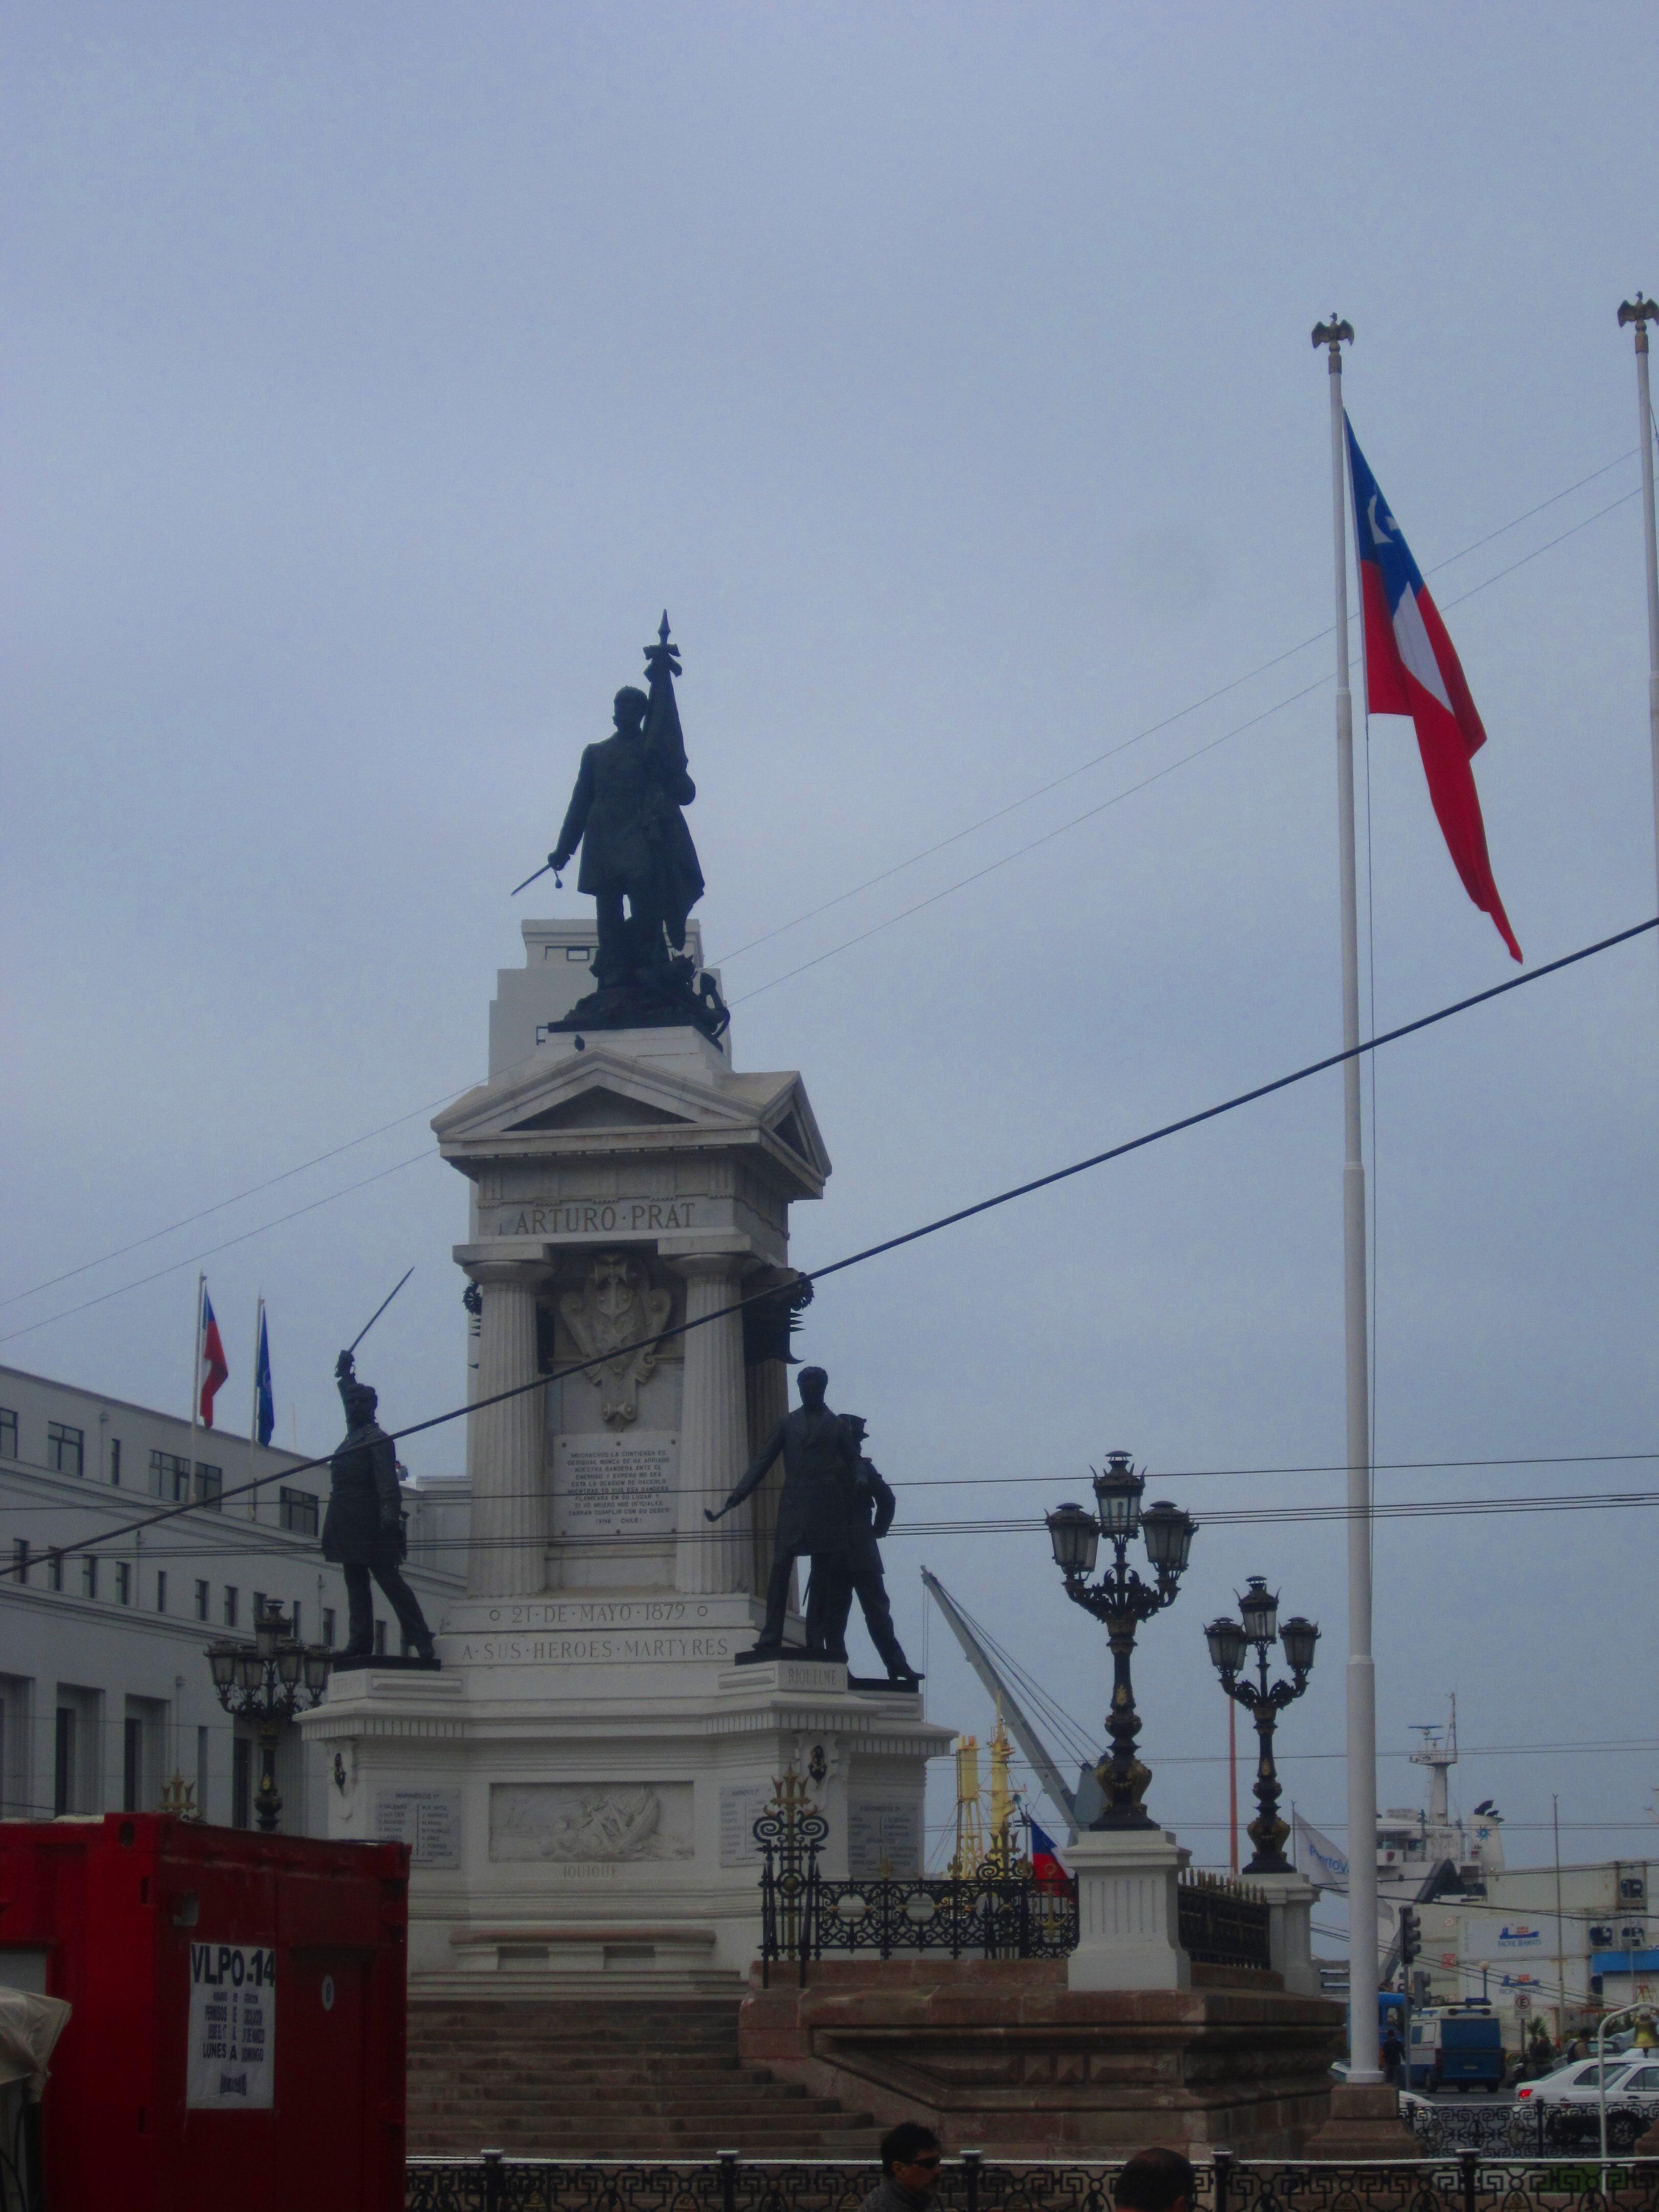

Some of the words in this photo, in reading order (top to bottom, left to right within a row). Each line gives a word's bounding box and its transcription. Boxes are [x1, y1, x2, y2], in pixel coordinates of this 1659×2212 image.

[515, 1206, 615, 1235] ARTURO
[631, 1203, 695, 1230] PRAT
[512, 1607, 530, 1623] 21
[544, 1606, 566, 1622] DE
[580, 1604, 631, 1622] MAYO
[646, 1603, 685, 1620] 1879
[462, 1645, 473, 1660] A
[484, 1642, 521, 1660] SUS
[534, 1640, 612, 1659] HEROES
[625, 1639, 728, 1657] MARTYRES
[203, 2043, 227, 2059] LUNES
[229, 2045, 237, 2061] A
